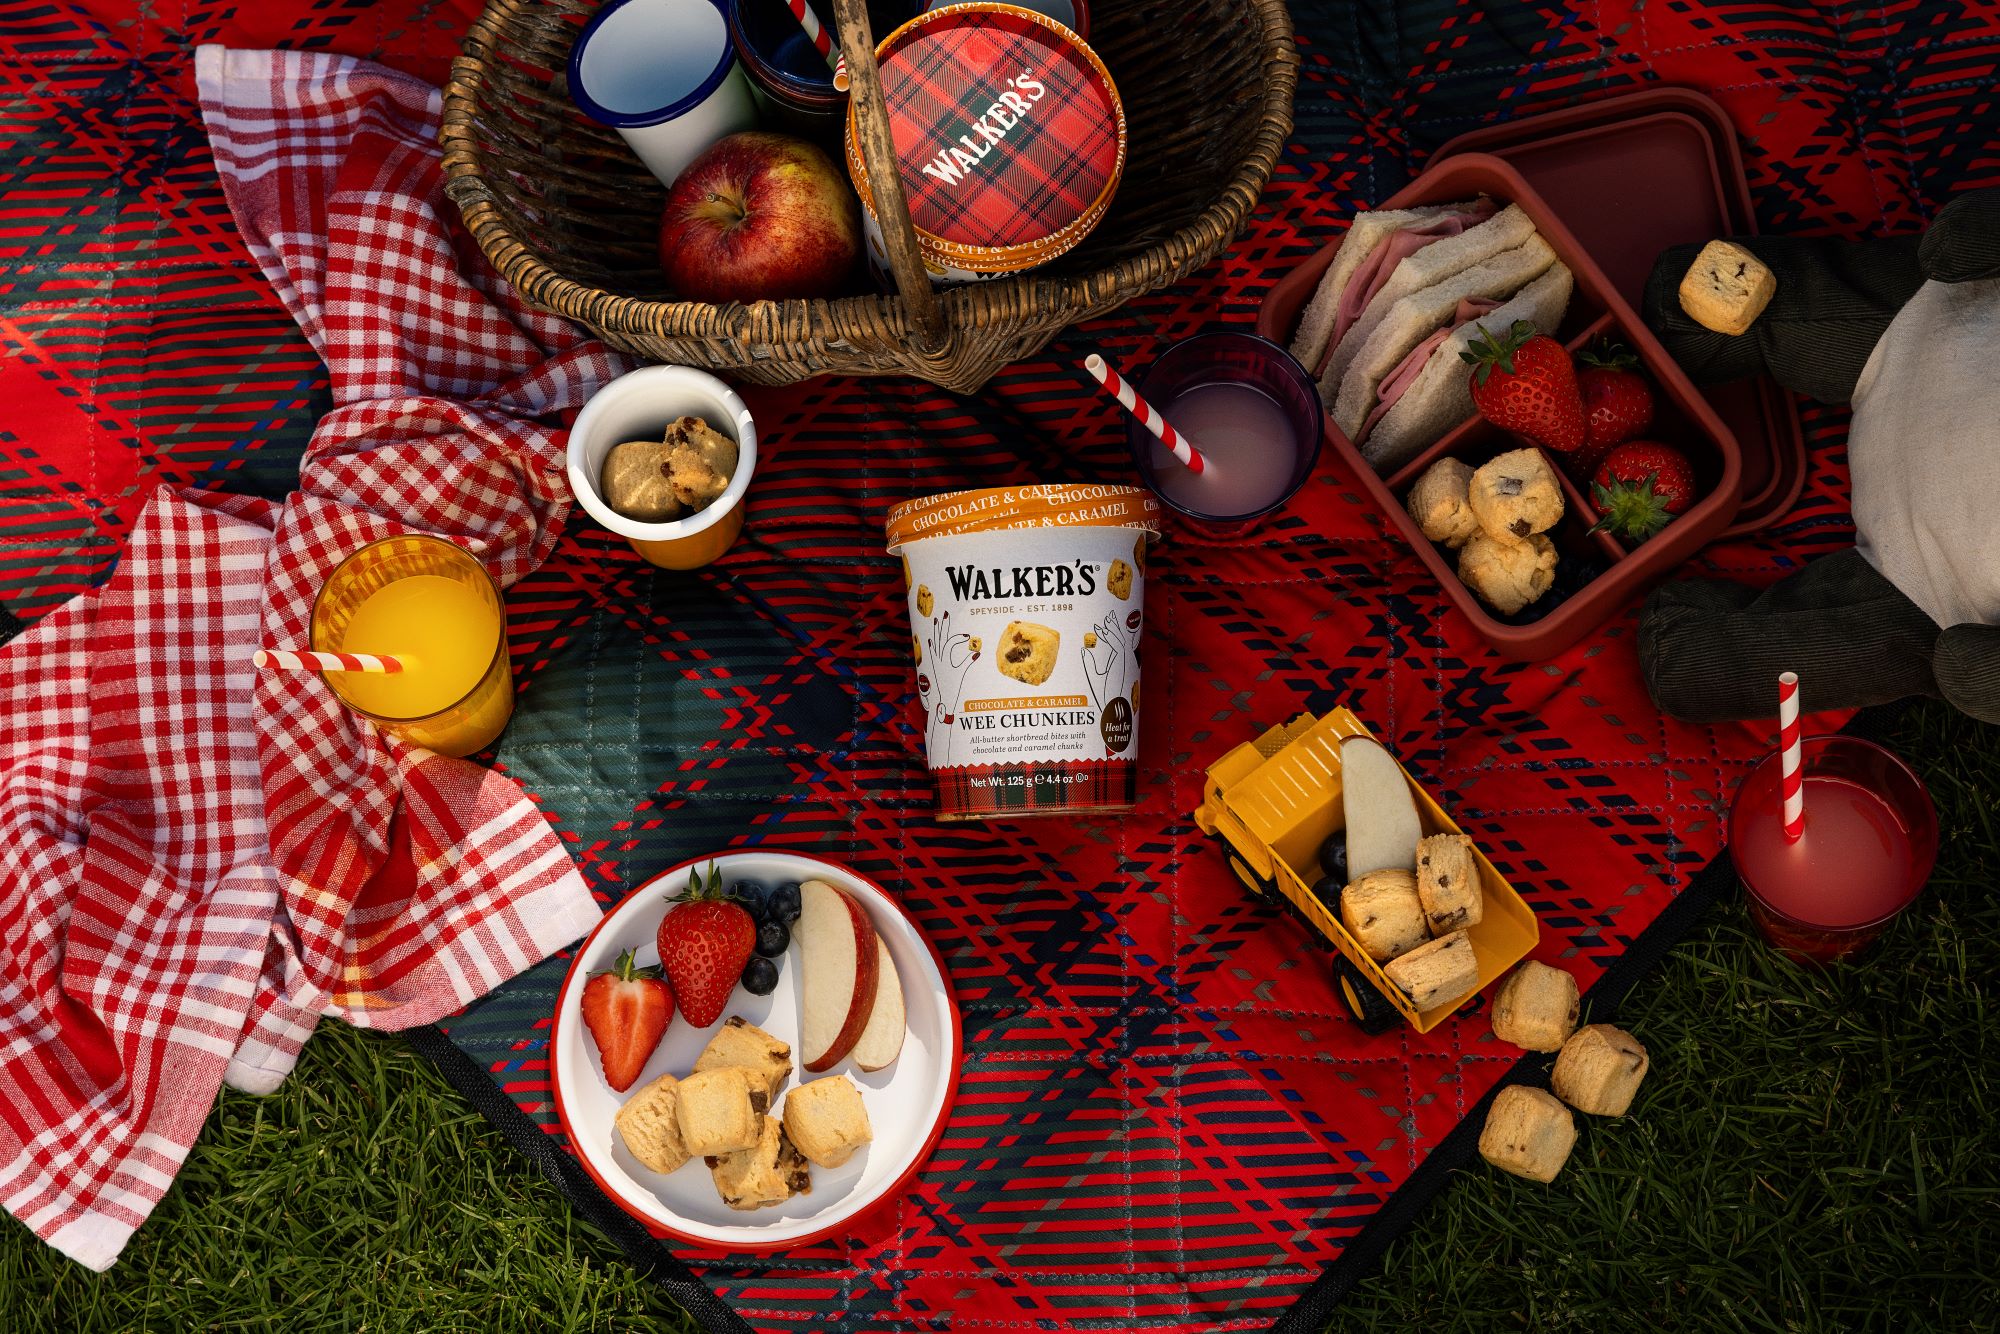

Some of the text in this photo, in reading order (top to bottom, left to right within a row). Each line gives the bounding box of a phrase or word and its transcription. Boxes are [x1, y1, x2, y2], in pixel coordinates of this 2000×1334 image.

[912, 494, 1000, 532] CHOCOLATE
[1003, 491, 1016, 504] &
[1057, 502, 1129, 525] CARAMEL
[970, 605, 1015, 616] SPEYSIDE
[1027, 604, 1049, 613] EST.
[1052, 603, 1073, 612] 1898
[968, 697, 1083, 711] CHOCOLATE & CARAMEL
[959, 710, 1095, 731] WEE CHUNKIES
[1105, 722, 1121, 732] Heat
[970, 731, 1086, 745] All-butter shortbread bites with
[1114, 734, 1129, 742] treat
[972, 742, 1084, 754] chocolate and caramel chunks
[970, 777, 987, 788] Net
[988, 776, 1005, 787] Wt.
[1007, 775, 1024, 786] 125
[1026, 777, 1033, 788] g
[1046, 774, 1060, 784] 4.4
[1062, 775, 1074, 784] oz
